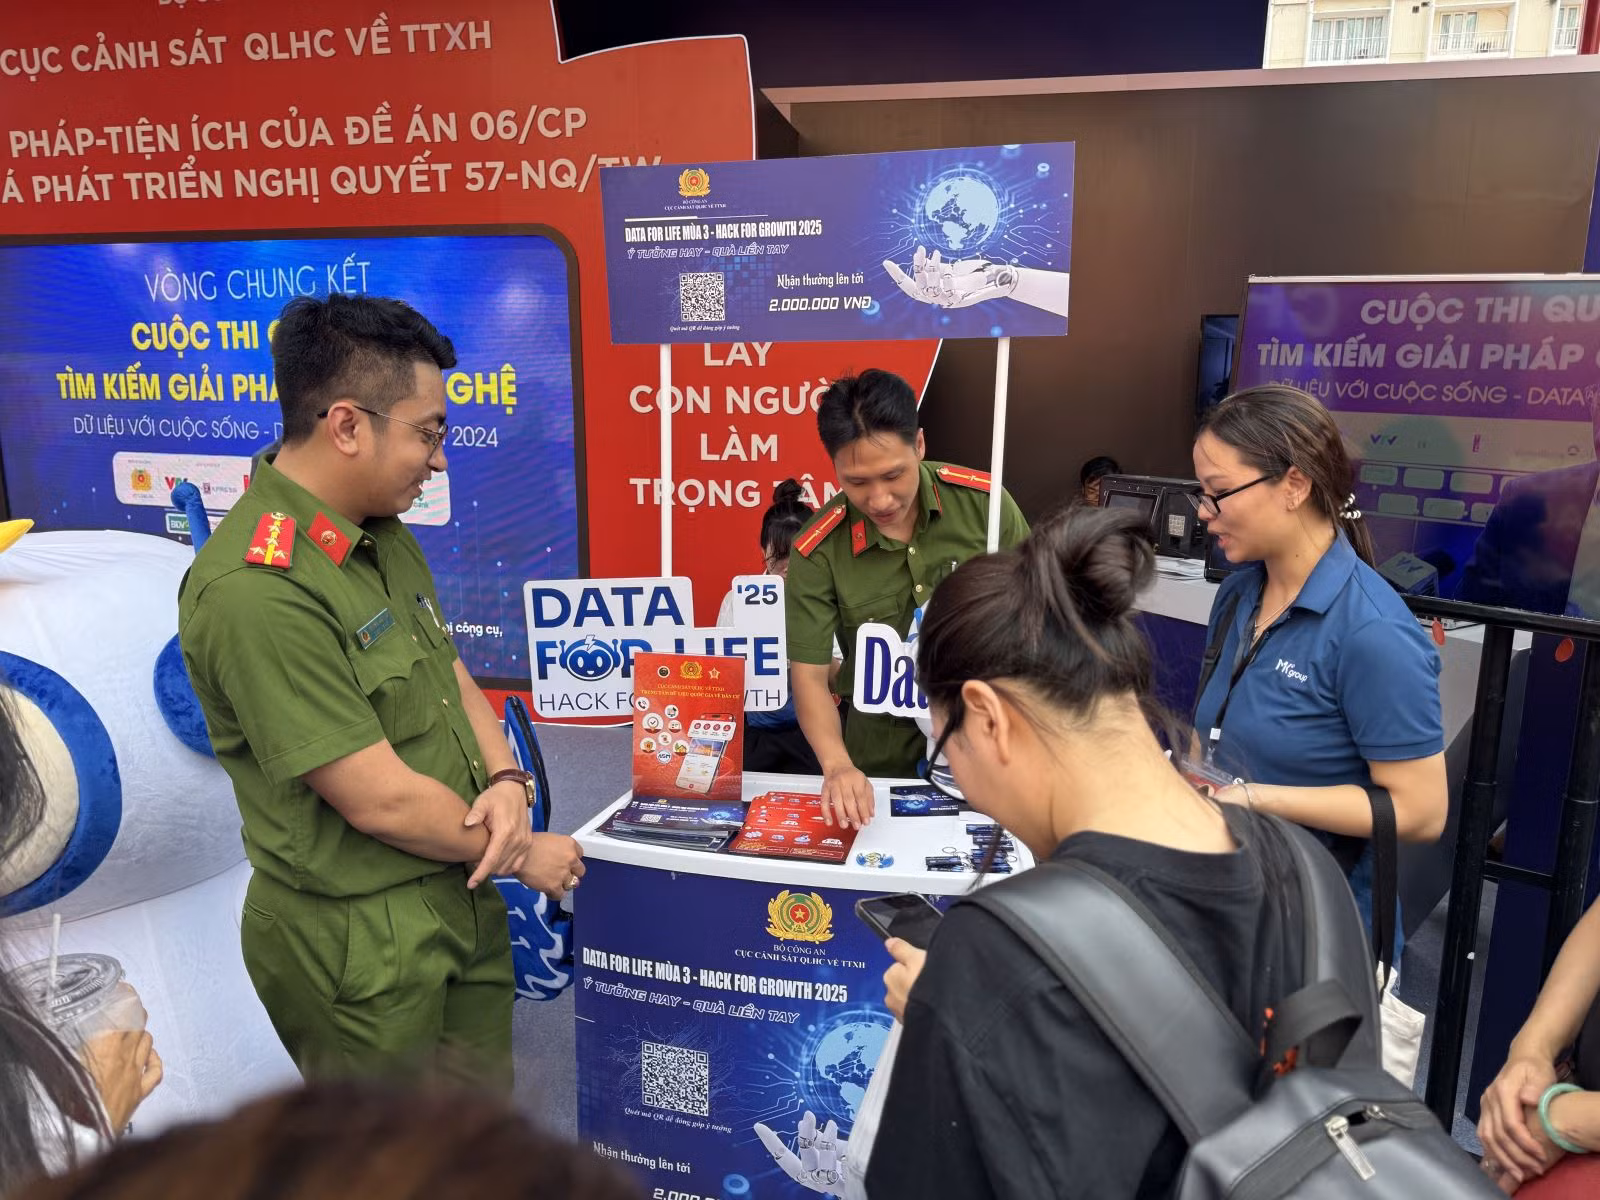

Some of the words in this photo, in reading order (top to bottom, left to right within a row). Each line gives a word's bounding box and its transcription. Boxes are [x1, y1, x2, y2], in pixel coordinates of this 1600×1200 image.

[0, 46, 64, 82] CỤC
[71, 32, 160, 72] CẢNH
[168, 28, 227, 66] SÁT
[244, 29, 337, 61] QLHC
[344, 12, 392, 56] VỀ
[400, 20, 492, 53] TTXH
[8, 117, 181, 161] PHÁP-TIỆN
[190, 113, 249, 152] ÍCH
[259, 106, 335, 149] CỦA
[344, 101, 394, 145] ĐỀ
[405, 104, 458, 144] ÁN
[470, 104, 588, 145] 06/CP
[32, 165, 114, 203] PHÁT
[123, 154, 223, 200] TRIỂN
[234, 167, 320, 204] NGHỊ
[330, 150, 452, 195] QUYẾT
[624, 227, 646, 243] DATA
[647, 226, 663, 242] FOR
[664, 225, 681, 241] LIFE
[682, 222, 702, 241] MÙA
[703, 224, 709, 240] 3
[715, 223, 739, 239] HACK
[740, 222, 757, 238] FOR
[758, 221, 797, 238] GROWTH
[798, 220, 822, 236] 2025
[636, 246, 678, 259] TƯỞNG
[679, 248, 703, 258] HAY
[712, 244, 736, 258] QUÀ
[738, 241, 765, 256] LIỀN
[766, 244, 789, 255] TAY
[144, 267, 217, 302] VÒNG
[227, 265, 316, 300] CHUNG
[326, 252, 371, 294] KẾT
[777, 273, 801, 290] Nhận
[802, 272, 834, 288] thưởng
[836, 271, 849, 285] lên
[851, 271, 864, 284] tới
[768, 297, 840, 311] 2.000.000
[843, 296, 872, 310] VNĐ
[1360, 292, 1464, 331] CUỘC
[1475, 295, 1532, 323] THI
[131, 313, 210, 358] CUỘC
[216, 320, 259, 350] THI
[1257, 336, 1304, 367] TÌM
[1312, 333, 1387, 369] KIẾM
[1395, 334, 1469, 370] GIẢI
[1480, 336, 1585, 371] PHÁP
[56, 364, 97, 400] TÌM
[103, 361, 161, 401] KIẾM
[168, 363, 224, 401] GIẢI
[444, 363, 517, 415] GHỆ
[629, 384, 711, 414] CON
[1335, 378, 1369, 399] VỚI
[1373, 379, 1437, 404] CUỘC
[1441, 380, 1508, 404] SỐNG
[1527, 386, 1586, 406] DATA
[73, 414, 94, 435] DỮ
[97, 414, 125, 438] LIỆU
[128, 414, 155, 437] VỚI
[159, 416, 207, 441] CUỘC
[211, 415, 260, 440] SỐNG
[452, 426, 499, 448] 2024
[700, 424, 778, 461] LÀM
[531, 586, 685, 629] DATA
[737, 584, 779, 606] '25
[456, 622, 484, 637] công
[486, 625, 503, 638] cụ,
[539, 692, 610, 711] HACK
[734, 949, 753, 959] CỤC
[754, 950, 779, 961] CẢNH
[781, 953, 798, 963] SÁT
[800, 956, 825, 965] QLHC
[841, 960, 866, 969] TTXH
[773, 943, 785, 953] BỘ
[787, 944, 812, 955] CÔNG
[813, 948, 826, 956] AN
[583, 946, 608, 970] DATA
[609, 953, 630, 974] FOR
[632, 957, 653, 978] LIFE
[655, 961, 681, 983] MÙA
[682, 966, 691, 985] 3
[699, 968, 732, 990] HACK
[734, 973, 757, 994] FOR
[758, 977, 813, 1000] GROWTH
[814, 983, 848, 1003] 2025
[595, 981, 647, 1001] TƯỞNG
[648, 992, 682, 1007] HAY
[692, 1000, 726, 1015] QUÀ
[728, 1002, 766, 1020] LIỀN
[768, 1009, 801, 1024] TAY
[593, 1141, 619, 1160] Nhận
[620, 1149, 656, 1170] thưởng
[658, 1156, 673, 1172] lên
[676, 1162, 691, 1174] tới
